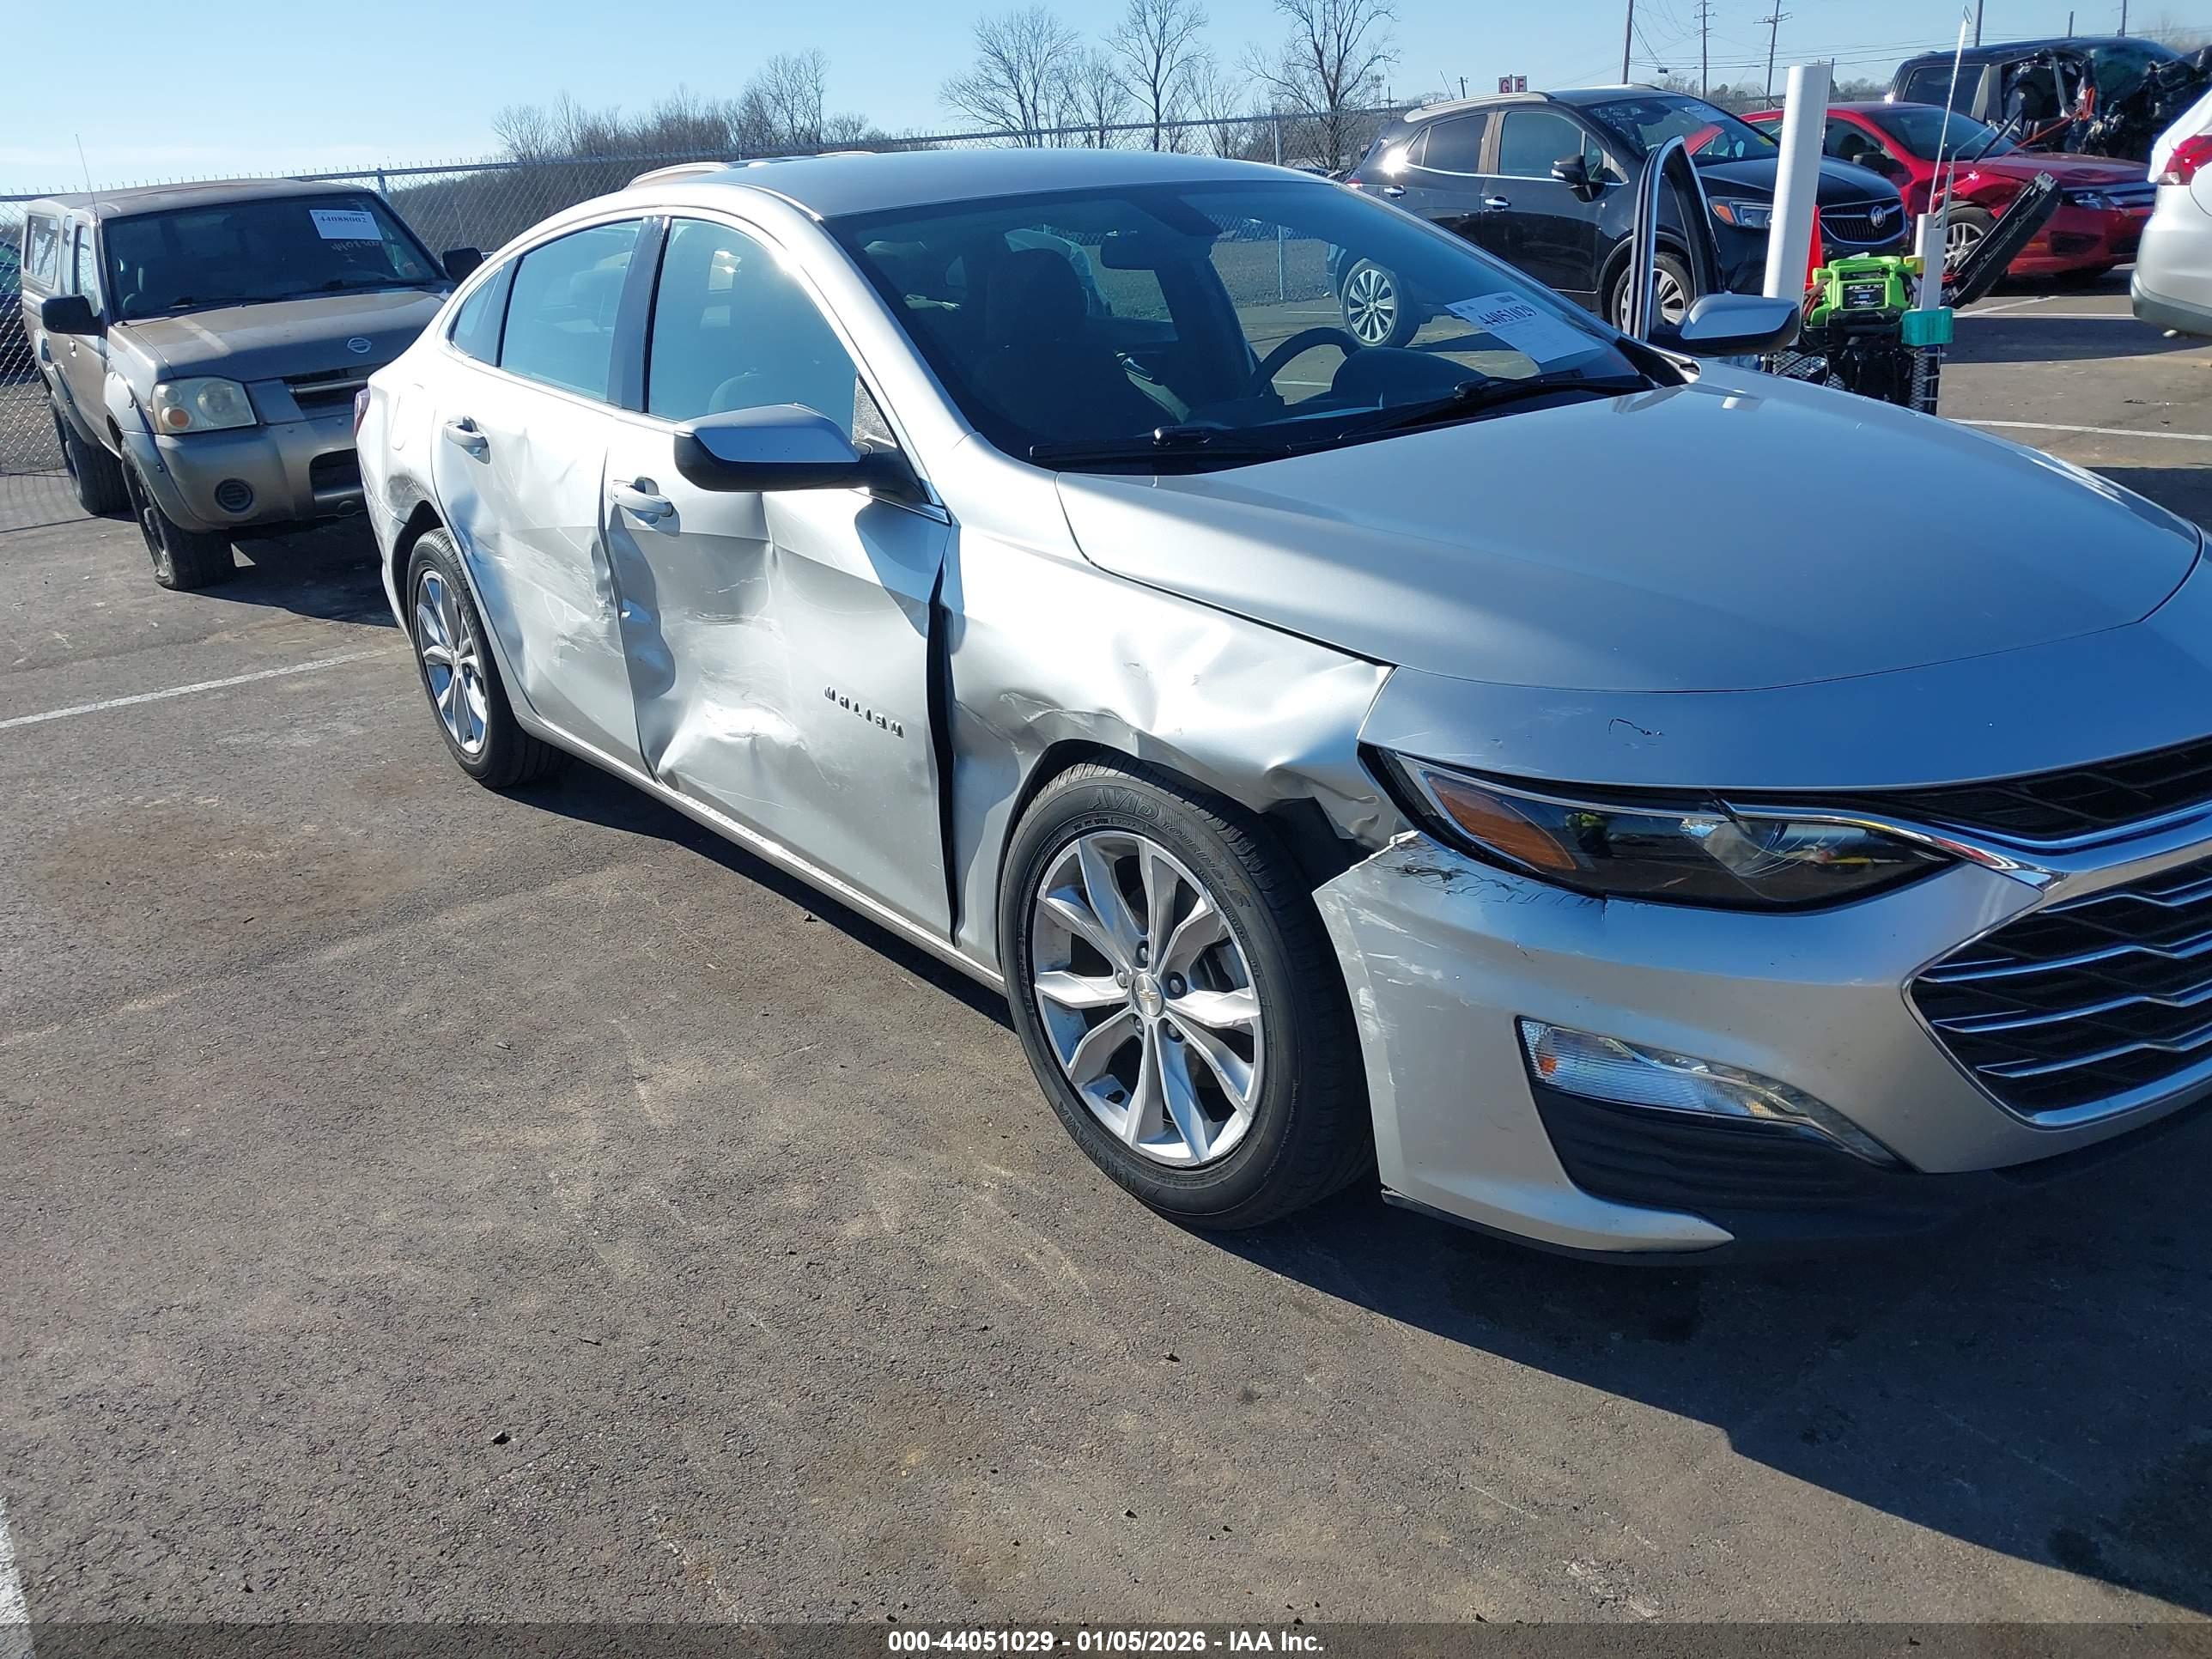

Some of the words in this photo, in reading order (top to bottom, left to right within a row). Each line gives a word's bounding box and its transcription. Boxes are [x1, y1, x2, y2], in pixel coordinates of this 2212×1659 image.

[1478, 305, 1538, 326] 44051029
[823, 686, 904, 739] MALIBU
[1088, 788, 1159, 820] AVID
